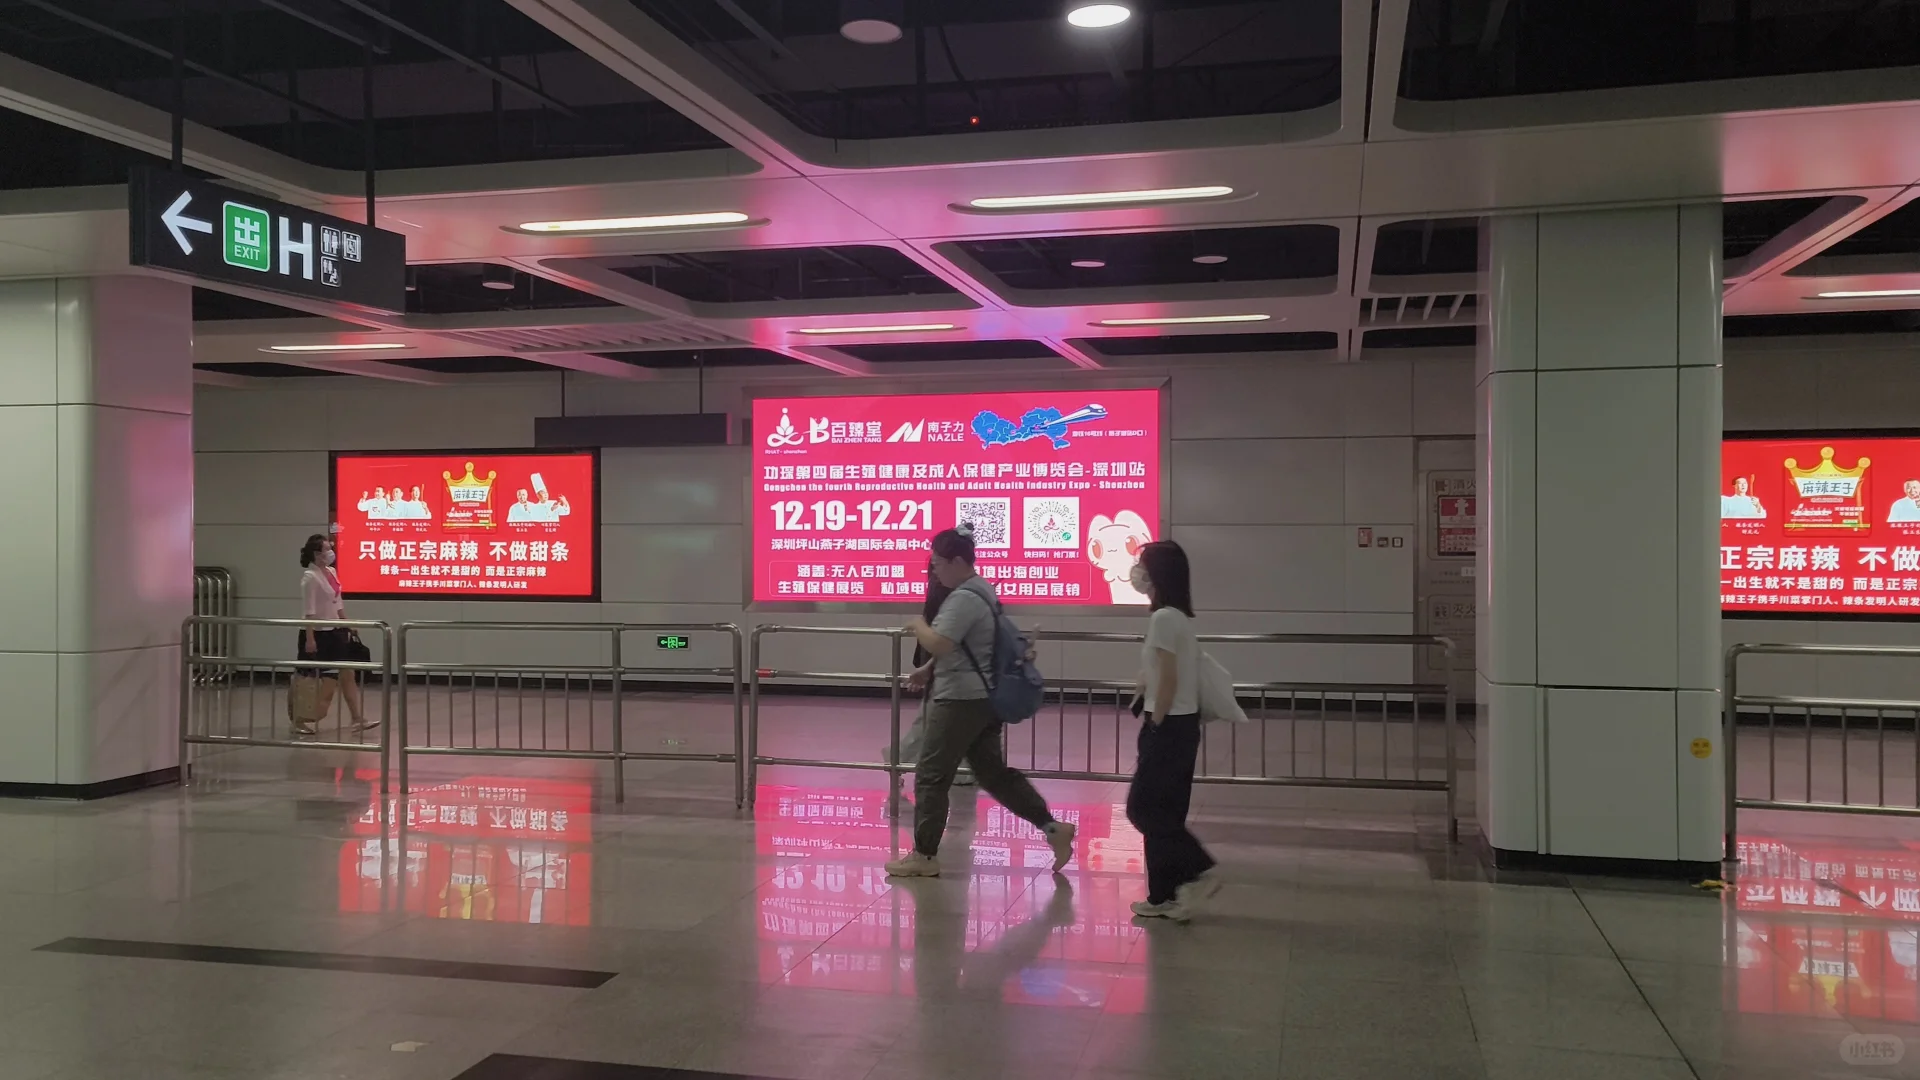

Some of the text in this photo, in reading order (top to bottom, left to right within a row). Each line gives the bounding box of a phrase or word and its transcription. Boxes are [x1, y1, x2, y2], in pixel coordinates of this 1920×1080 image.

[234, 216, 260, 247] 出
[234, 245, 260, 260] EXIT
[278, 216, 313, 280] H
[927, 421, 964, 432] 南子力
[927, 432, 964, 442] NAZLE
[808, 483, 823, 491] the
[825, 483, 853, 491] fourth
[855, 482, 914, 491] Reproductive
[916, 482, 946, 490] Health
[948, 482, 965, 490] and
[967, 481, 992, 490] Adult
[994, 481, 1025, 489] Health
[1026, 481, 1067, 490] Industry
[1069, 480, 1091, 490] Expo
[1099, 480, 1145, 489] Shenzhen
[1802, 480, 1854, 495] 麻辣王子
[453, 489, 487, 501] 麻辣王子
[770, 499, 932, 531] 12.19-12.21
[358, 539, 569, 562] 只做正宗麻辣 不做甜条
[771, 538, 932, 551] 深圳坪山燕子湖国际会展中心
[1720, 544, 1920, 572] 正宗麻辣 不做
[380, 564, 547, 577] 辣条一出生就不是甜的 而是正宗麻辣
[881, 581, 929, 595] 私域电
[1720, 575, 1844, 590] 一出生就不是甜的
